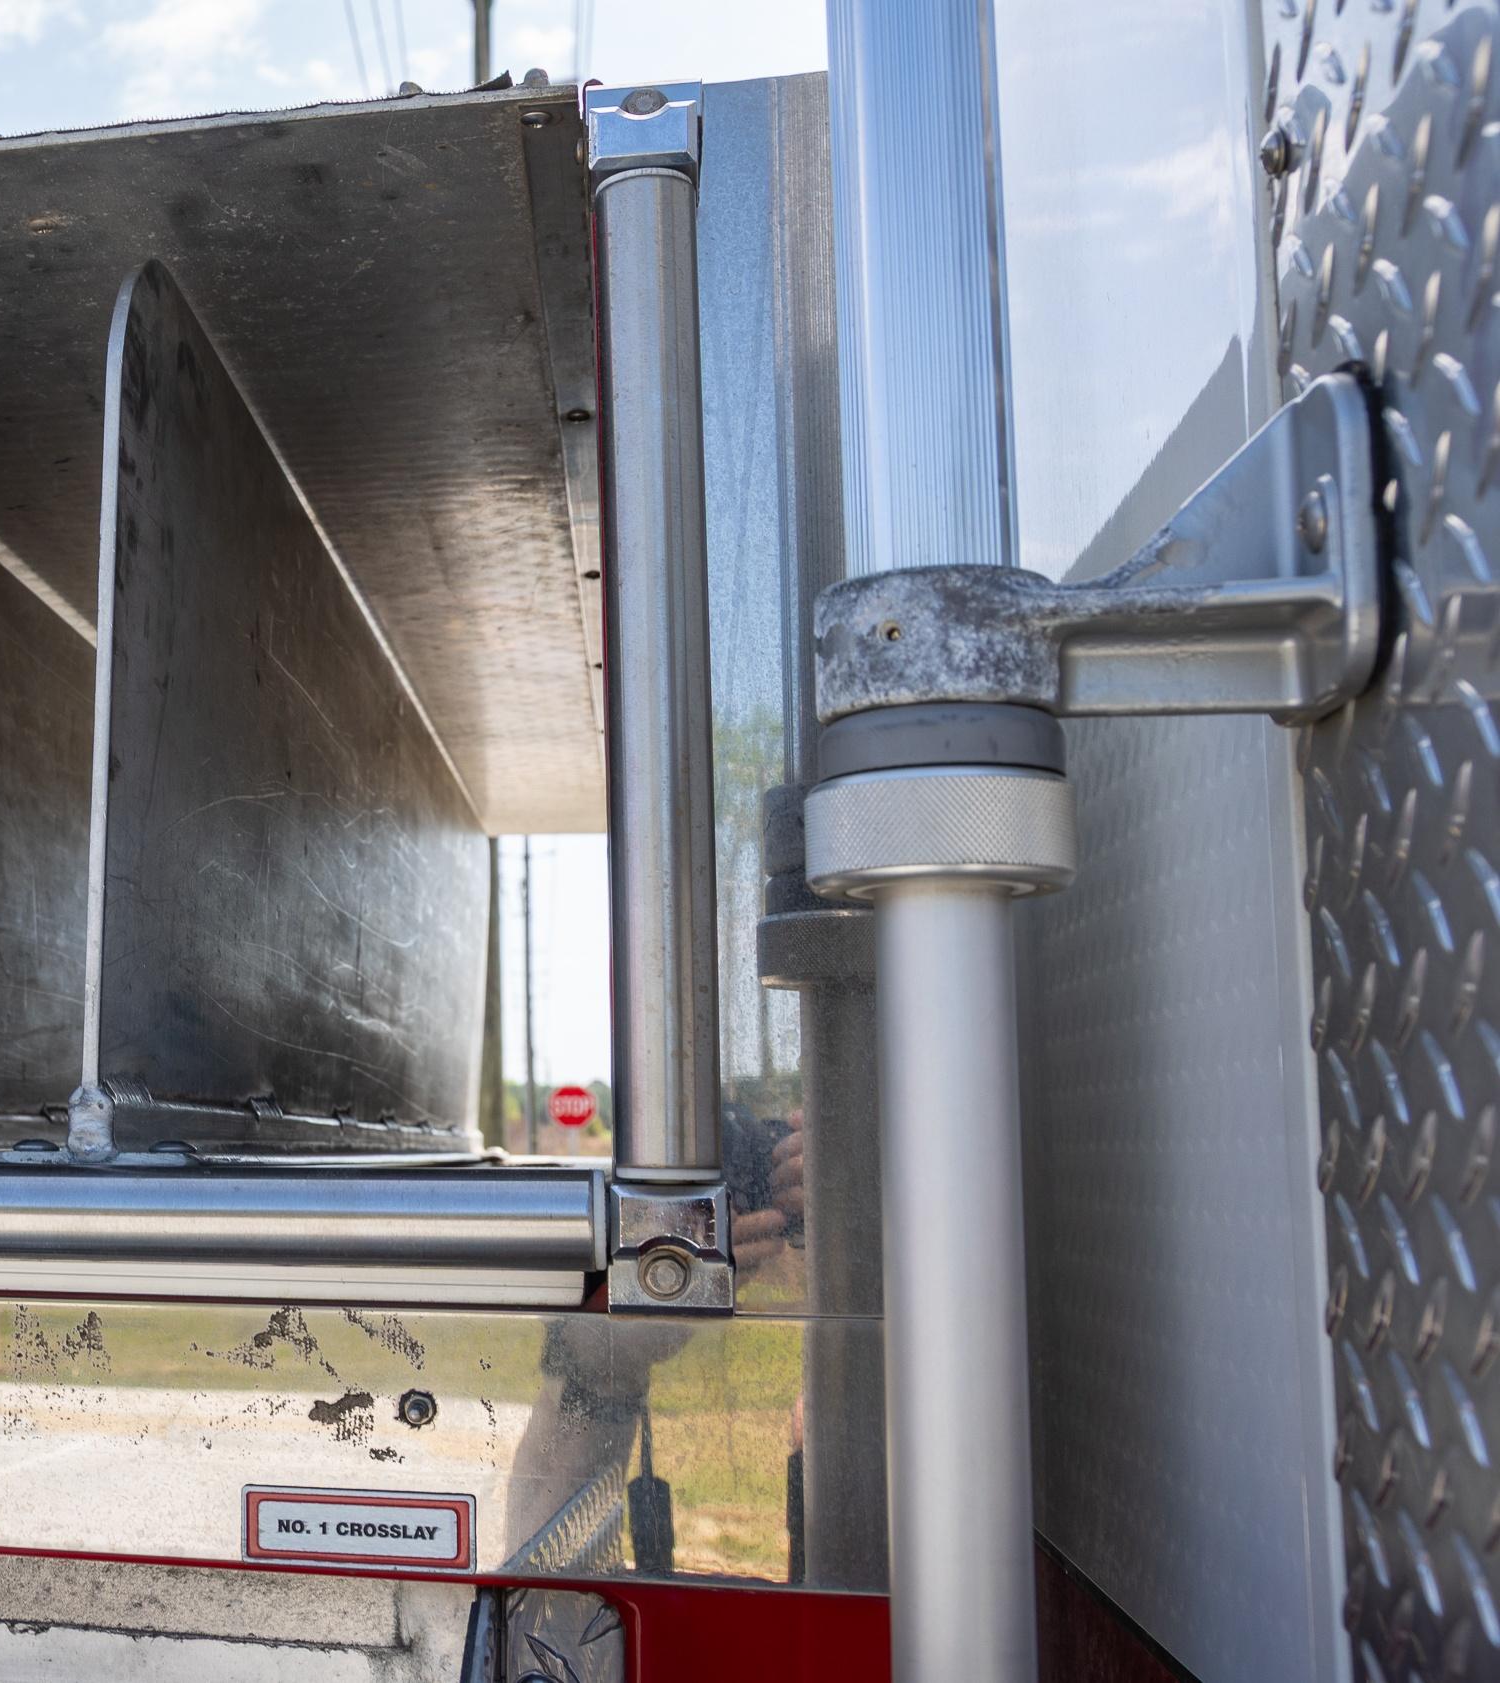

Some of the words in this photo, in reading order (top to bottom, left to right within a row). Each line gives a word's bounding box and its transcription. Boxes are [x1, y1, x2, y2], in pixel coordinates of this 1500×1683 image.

[553, 1096, 592, 1118] STOP
[277, 1518, 311, 1535] NO.
[319, 1521, 328, 1535] 1
[336, 1521, 438, 1541] CROSSLAY
